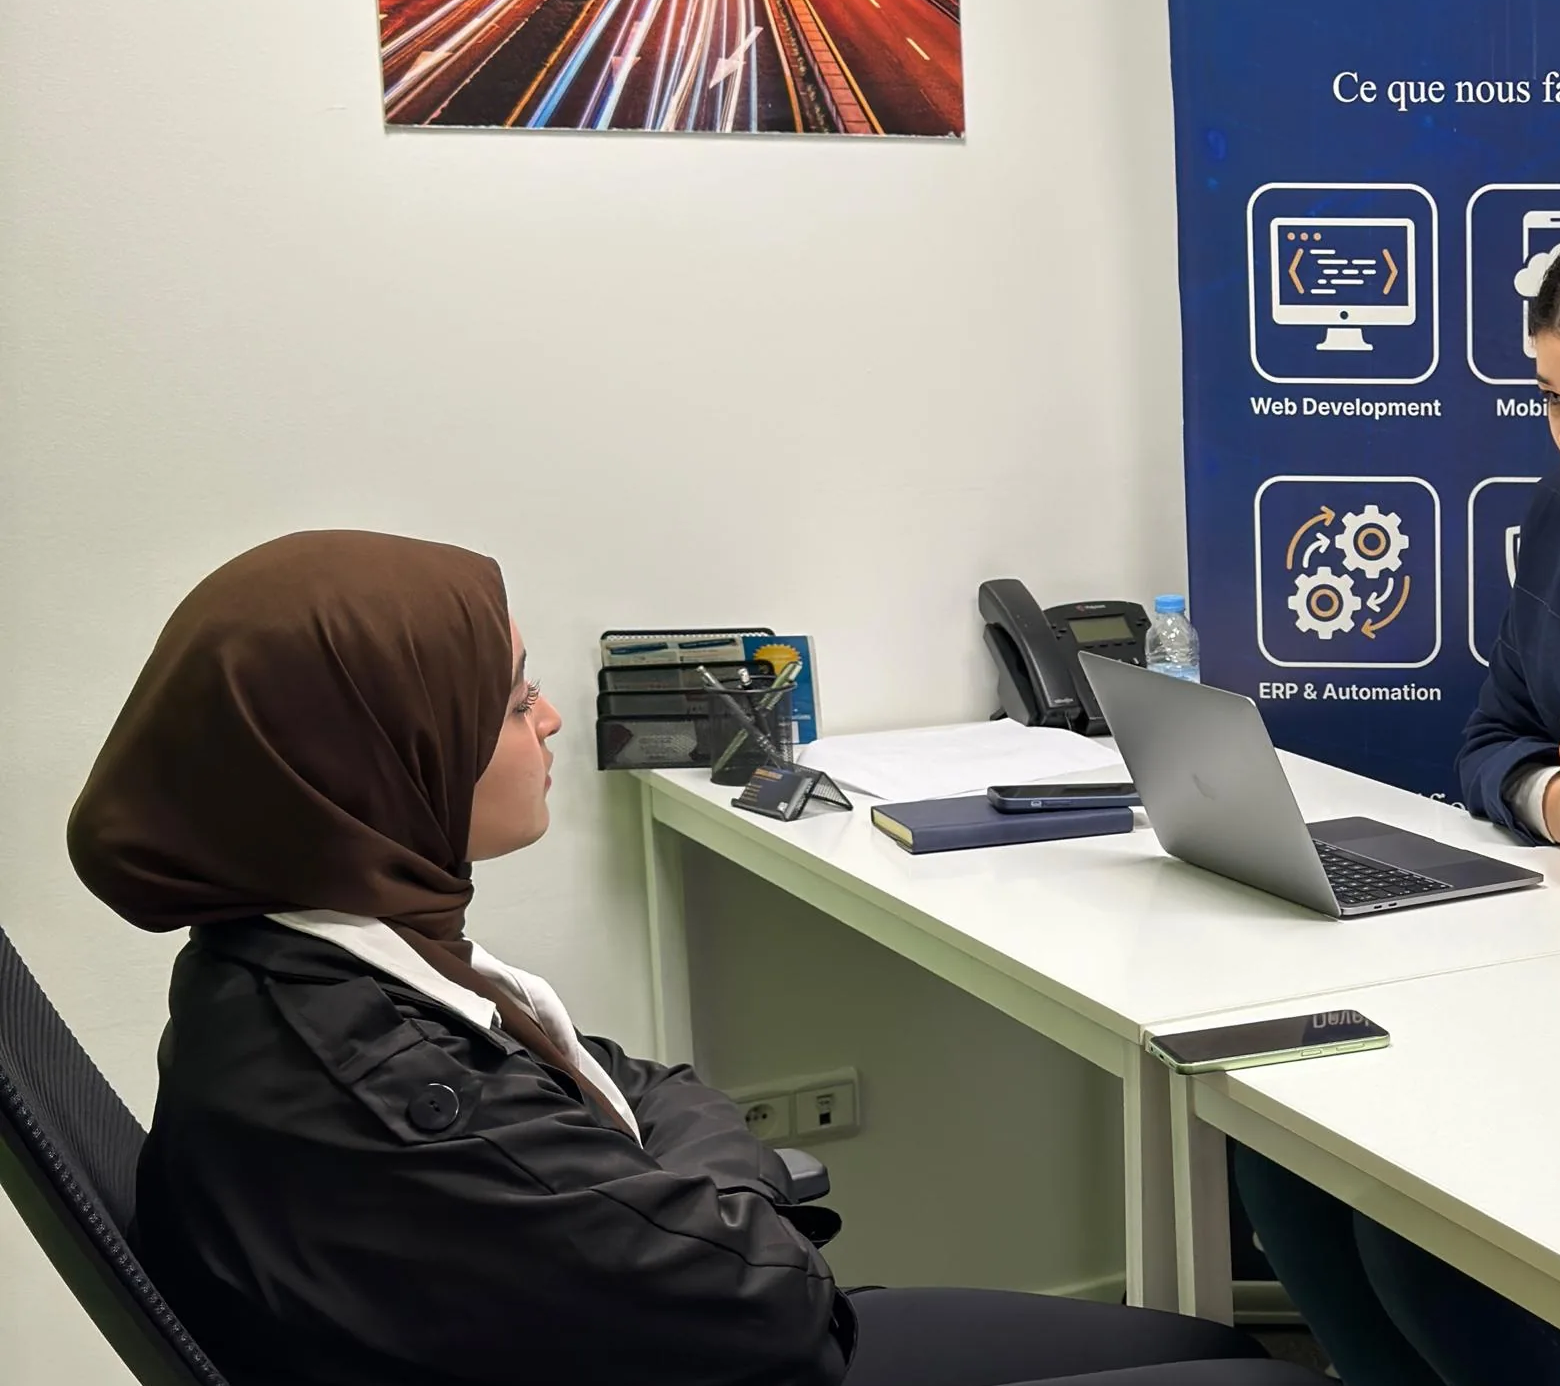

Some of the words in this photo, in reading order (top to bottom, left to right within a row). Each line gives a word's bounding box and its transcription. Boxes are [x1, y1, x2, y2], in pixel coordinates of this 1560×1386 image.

[1332, 71, 1377, 103] Ce
[1387, 81, 1445, 112] que
[1454, 81, 1531, 103] nous
[1250, 397, 1298, 416] Web
[1302, 397, 1442, 421] Development
[1496, 398, 1548, 417] Mobi
[1259, 682, 1299, 699] ERP
[1303, 682, 1317, 700] &
[1322, 683, 1441, 701] Automation
